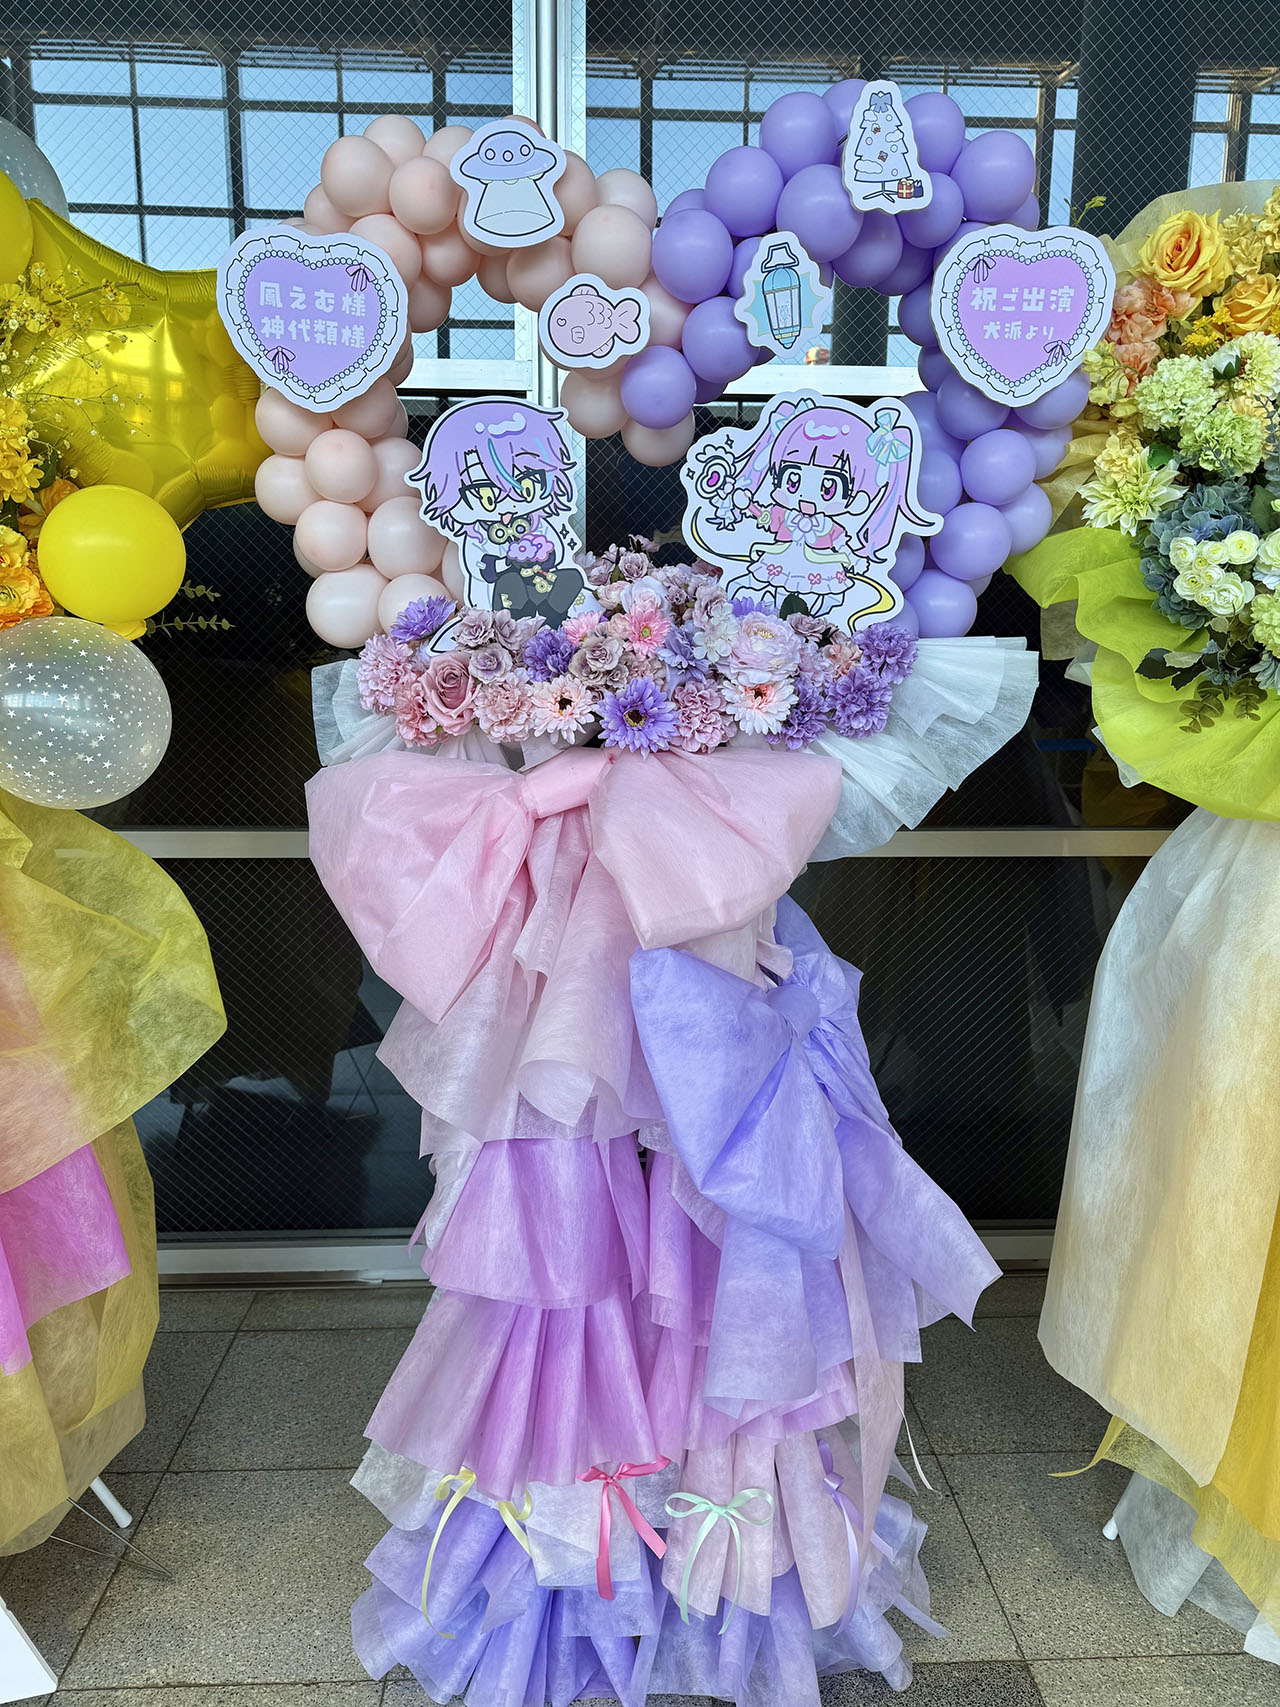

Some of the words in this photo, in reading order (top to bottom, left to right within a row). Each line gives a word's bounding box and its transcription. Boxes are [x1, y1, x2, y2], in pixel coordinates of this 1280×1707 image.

[970, 285, 1075, 312] 祝ご出演
[261, 315, 365, 348] 神代類様
[983, 320, 1054, 340] 犬派より
